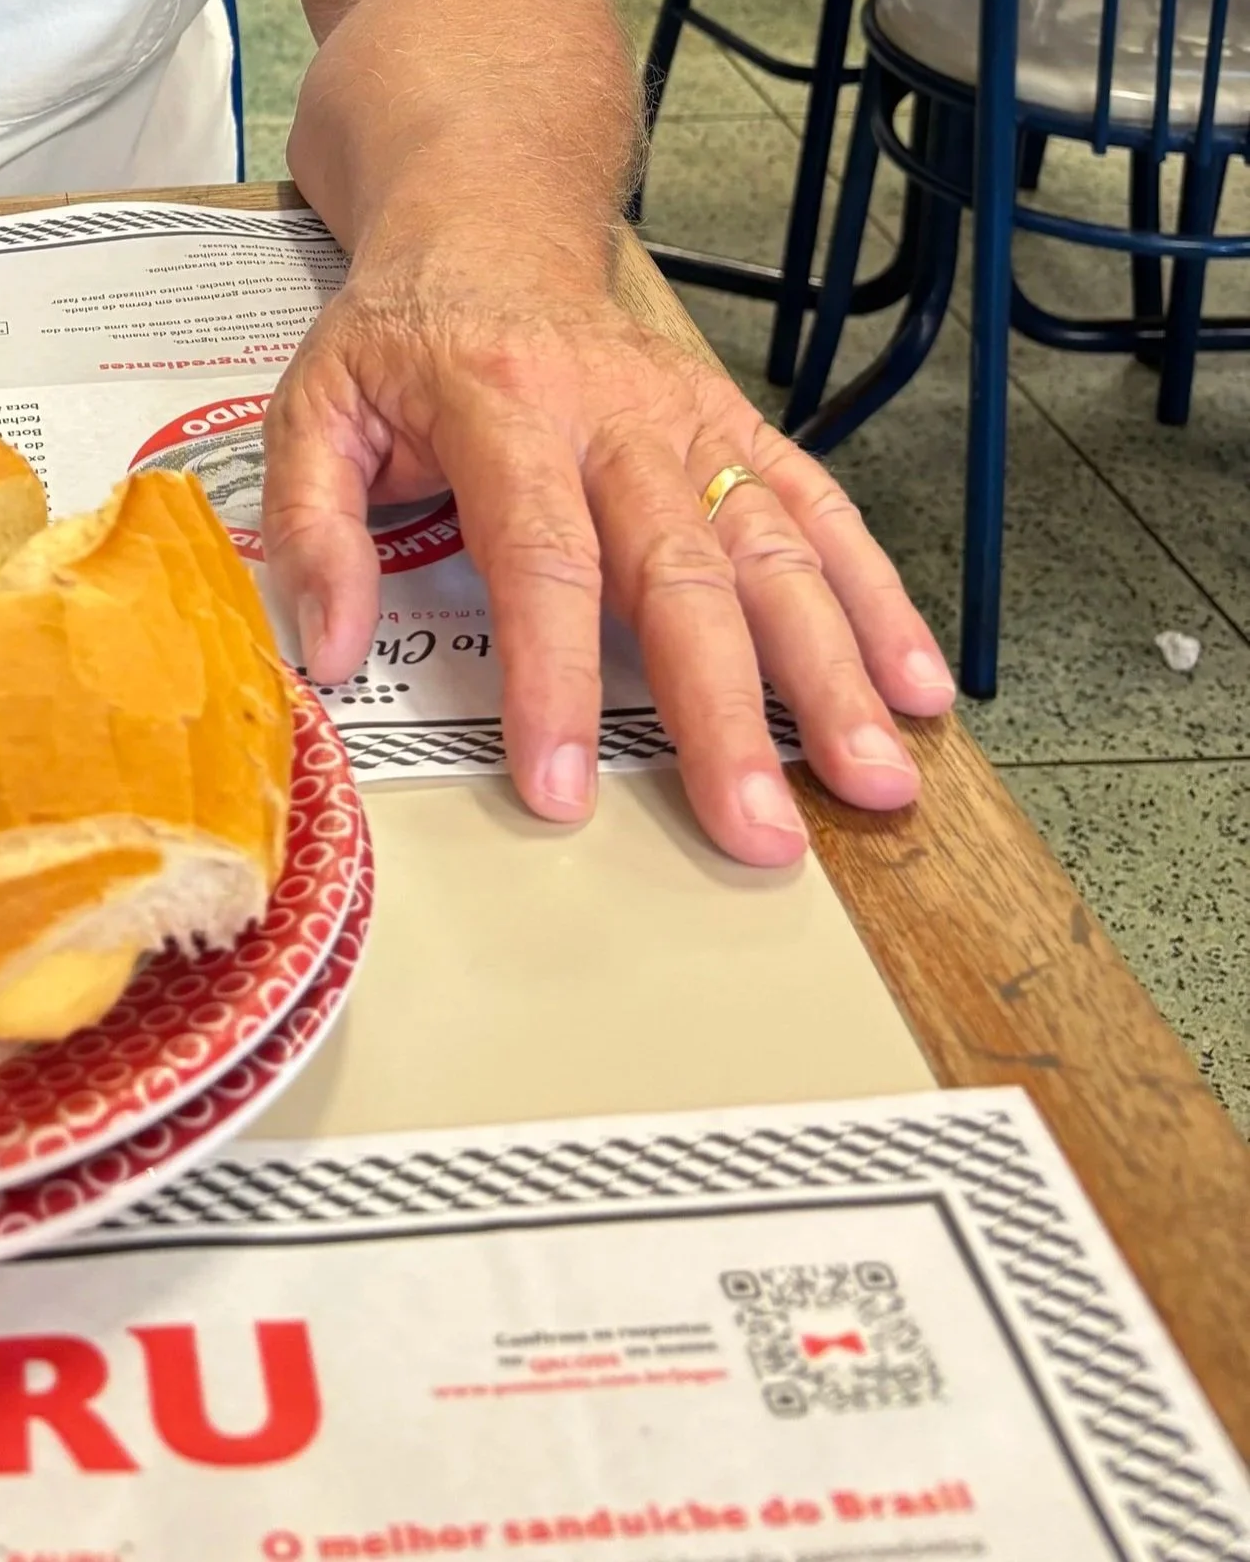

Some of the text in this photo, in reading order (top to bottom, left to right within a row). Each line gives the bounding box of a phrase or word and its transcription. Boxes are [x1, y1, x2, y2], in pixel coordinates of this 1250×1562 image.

[145, 260, 217, 274] buraquinhos.
[108, 289, 157, 300] utilizado
[159, 285, 193, 295] muito
[241, 287, 272, 295] come
[51, 297, 79, 306] fazer
[81, 293, 106, 302] para
[175, 290, 239, 304] geralmente
[119, 301, 152, 310] forma
[194, 314, 233, 324] recebe
[235, 311, 257, 320] que
[104, 323, 128, 331] uma
[148, 319, 181, 327] nome
[213, 321, 273, 333] brasileiros
[276, 317, 306, 327] pelos
[221, 335, 246, 343] com
[242, 342, 300, 355] uru?
[99, 356, 257, 371] ingredientes
[5, 402, 39, 411] bota
[7, 428, 42, 438] Bota
[24, 441, 44, 450] do
[374, 519, 459, 561] ELHO
[452, 633, 492, 658] to
[259, 1528, 303, 1562] O
[317, 1521, 490, 1558] melhor
[758, 1492, 824, 1528] do
[828, 1479, 977, 1523] Brasil
